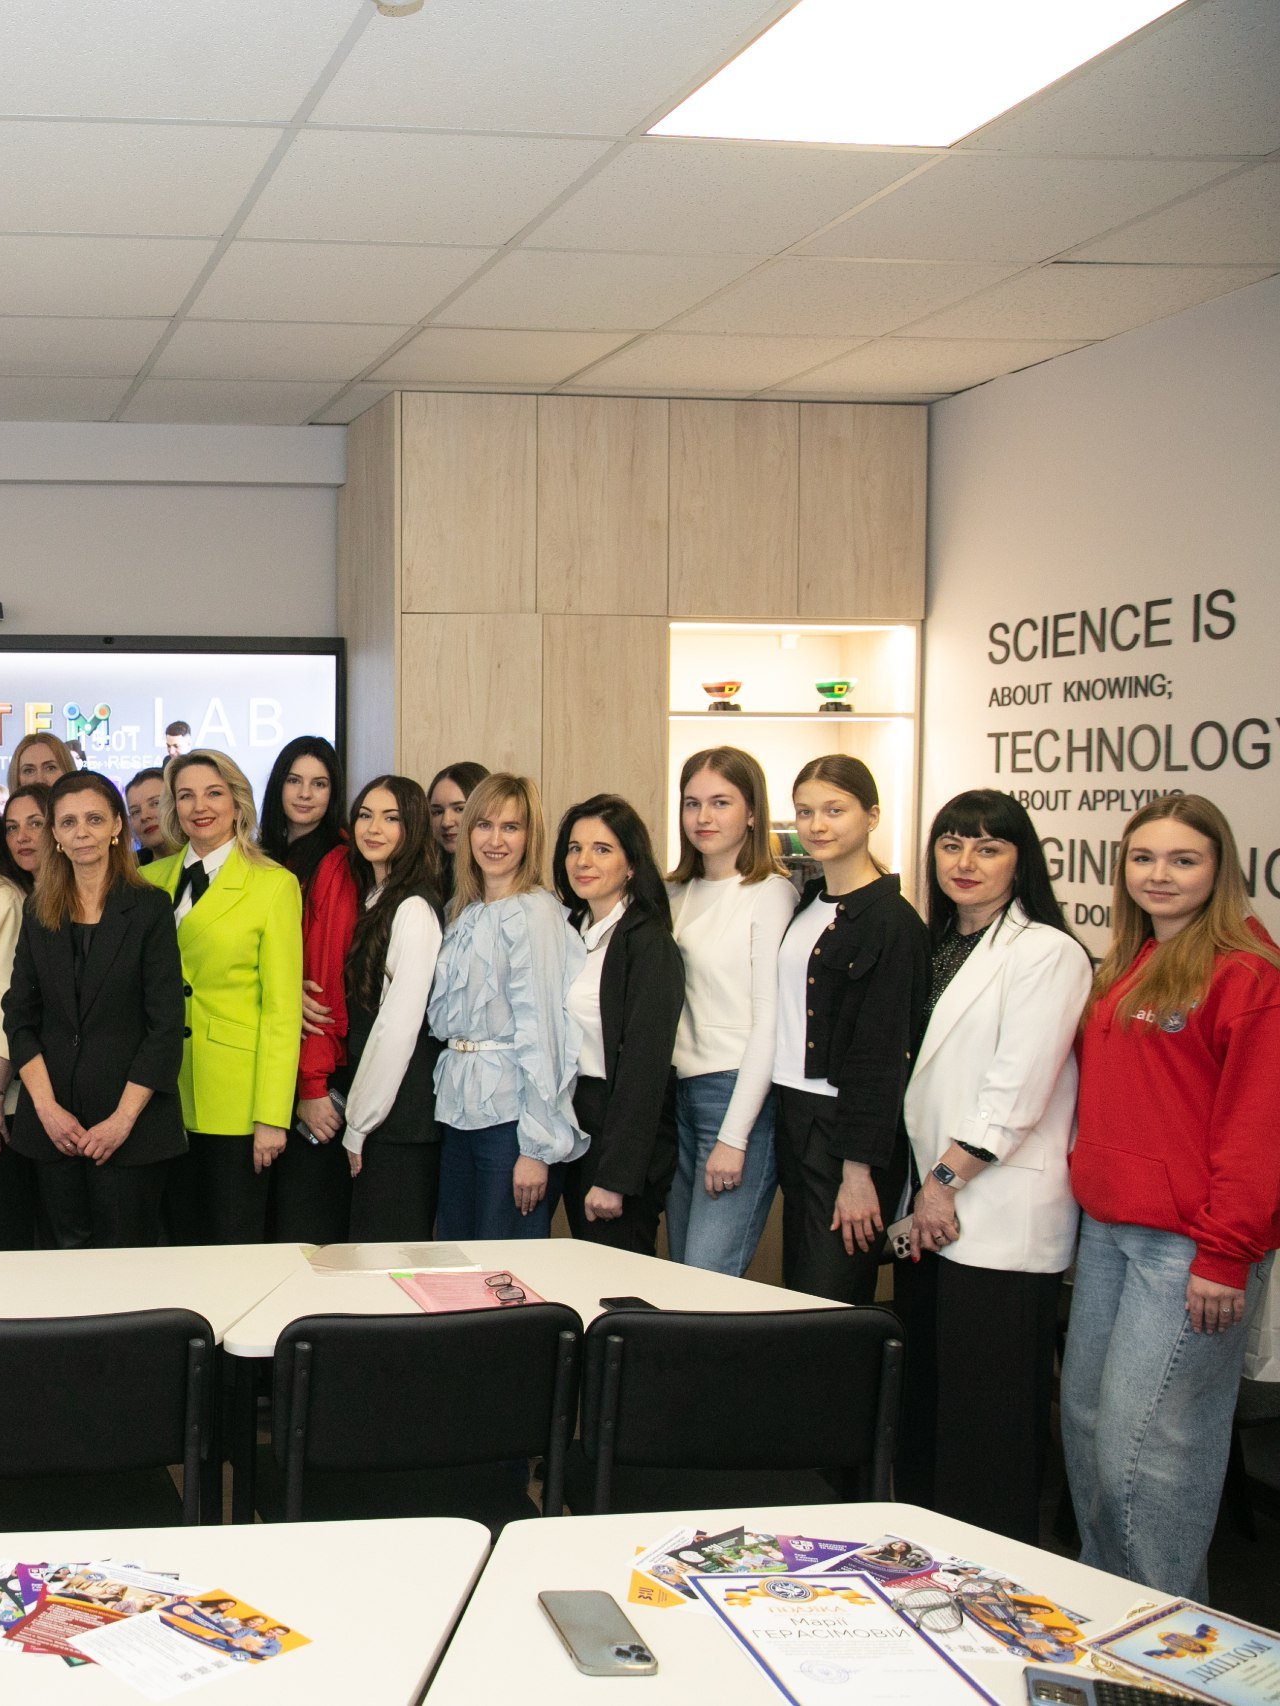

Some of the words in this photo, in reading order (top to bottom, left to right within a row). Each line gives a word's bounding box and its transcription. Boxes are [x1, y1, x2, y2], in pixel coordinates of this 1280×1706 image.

[988, 597, 1173, 665] SCIENCE
[1192, 588, 1237, 643] IS
[988, 682, 1053, 707] ABOUT
[1063, 673, 1173, 703] KNOWING;
[987, 717, 1280, 774] TECHNOLOG
